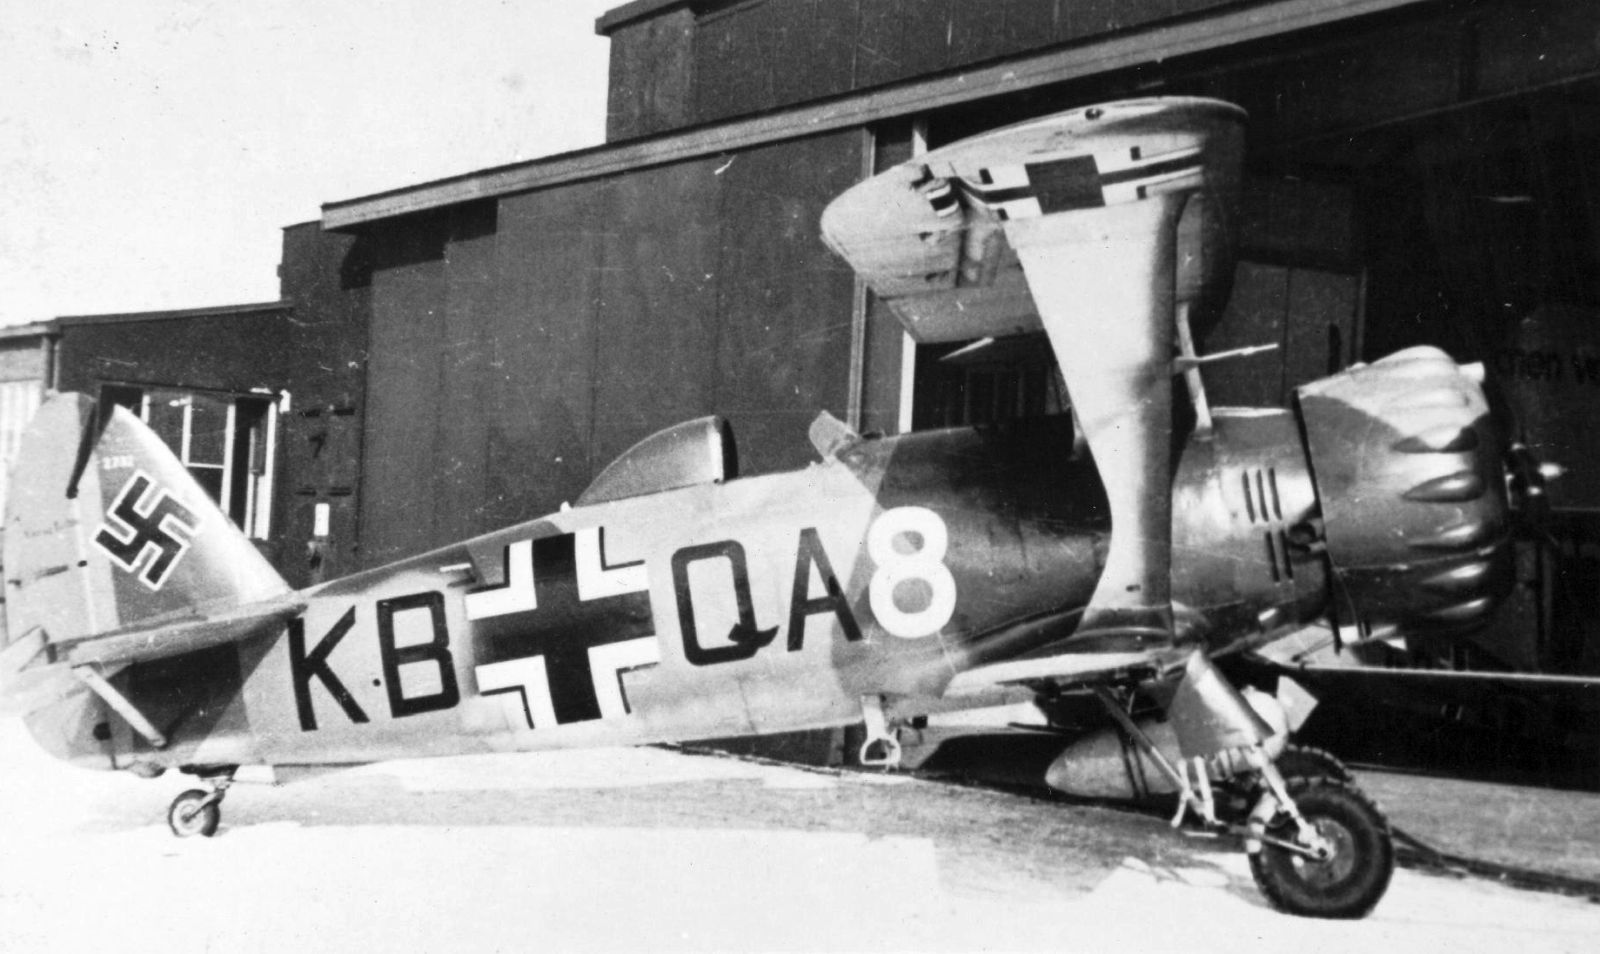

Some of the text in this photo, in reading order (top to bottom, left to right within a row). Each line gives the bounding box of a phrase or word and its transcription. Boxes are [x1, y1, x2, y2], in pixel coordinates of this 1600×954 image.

[309, 431, 328, 458] 7
[671, 527, 863, 666] QA
[867, 506, 956, 638] 8
[287, 590, 460, 732] KB
